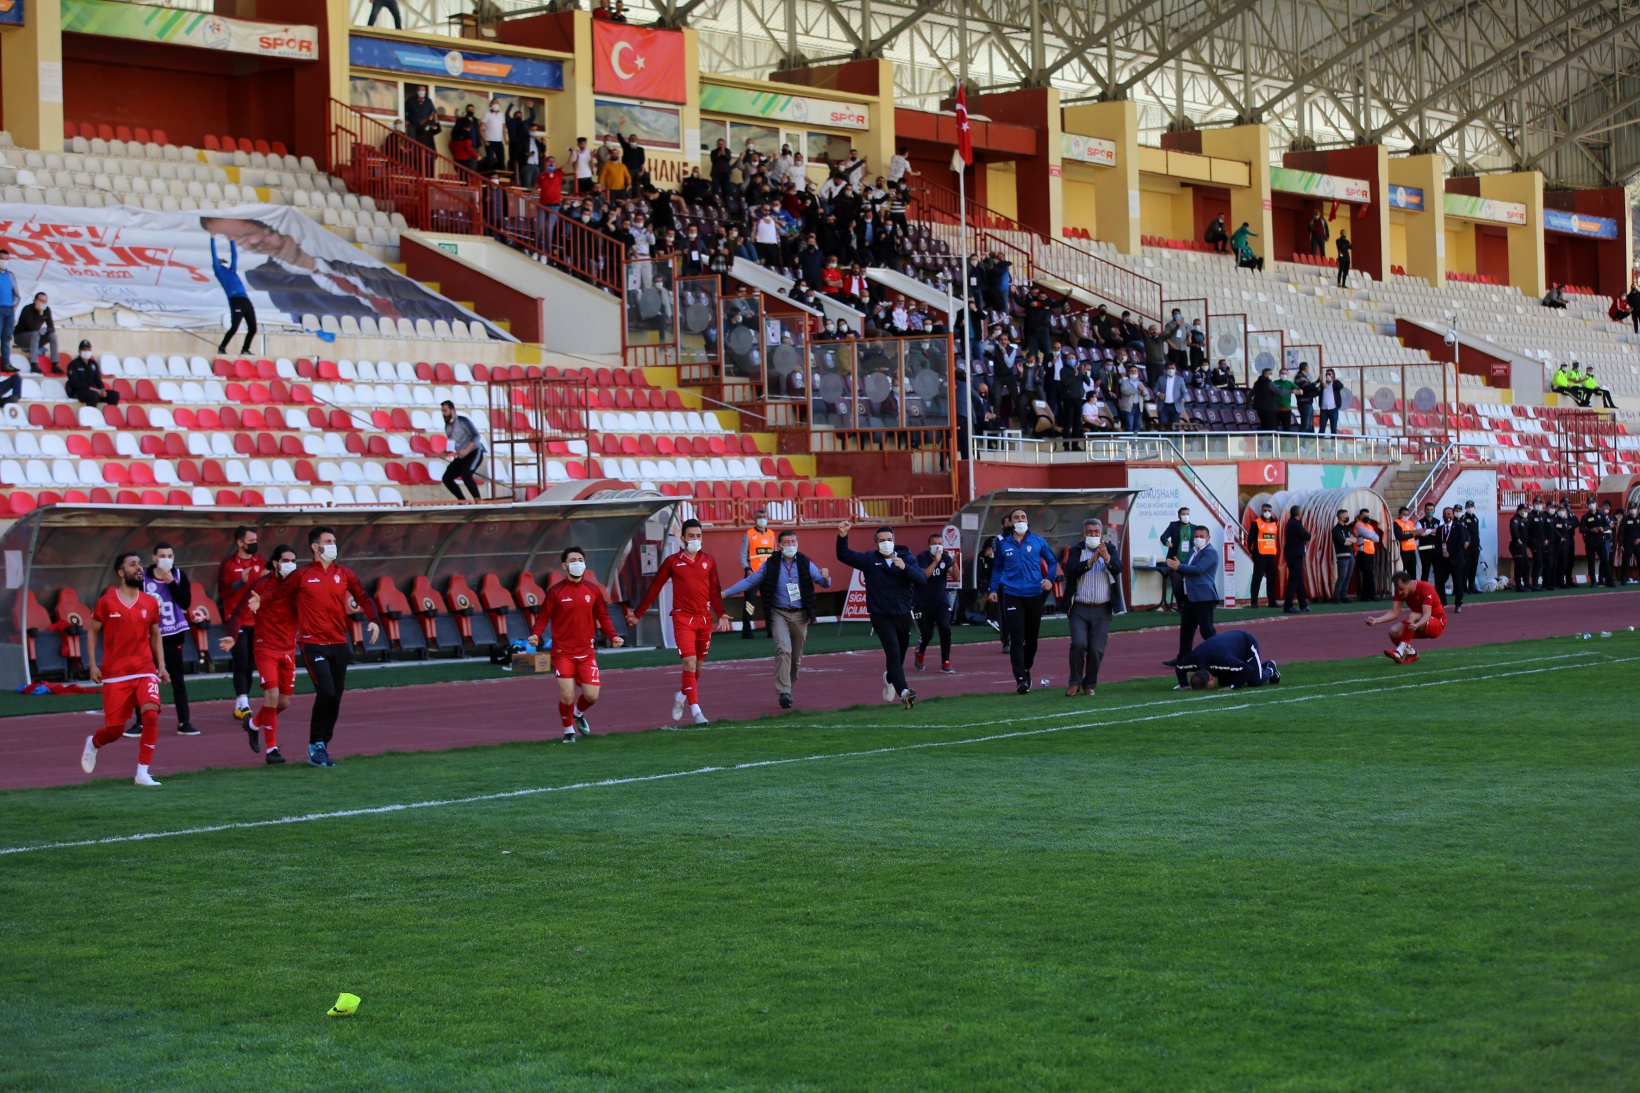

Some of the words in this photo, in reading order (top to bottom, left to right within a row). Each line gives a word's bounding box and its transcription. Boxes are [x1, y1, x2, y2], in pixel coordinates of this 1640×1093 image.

[258, 36, 313, 53] SPOR
[830, 112, 866, 125] SPOR
[1086, 147, 1114, 160] SPOR
[647, 158, 690, 184] HANE
[1345, 187, 1369, 199] SPOR
[1506, 211, 1526, 220] SPOR
[849, 592, 866, 603] SİGA
[147, 682, 160, 695] 20
